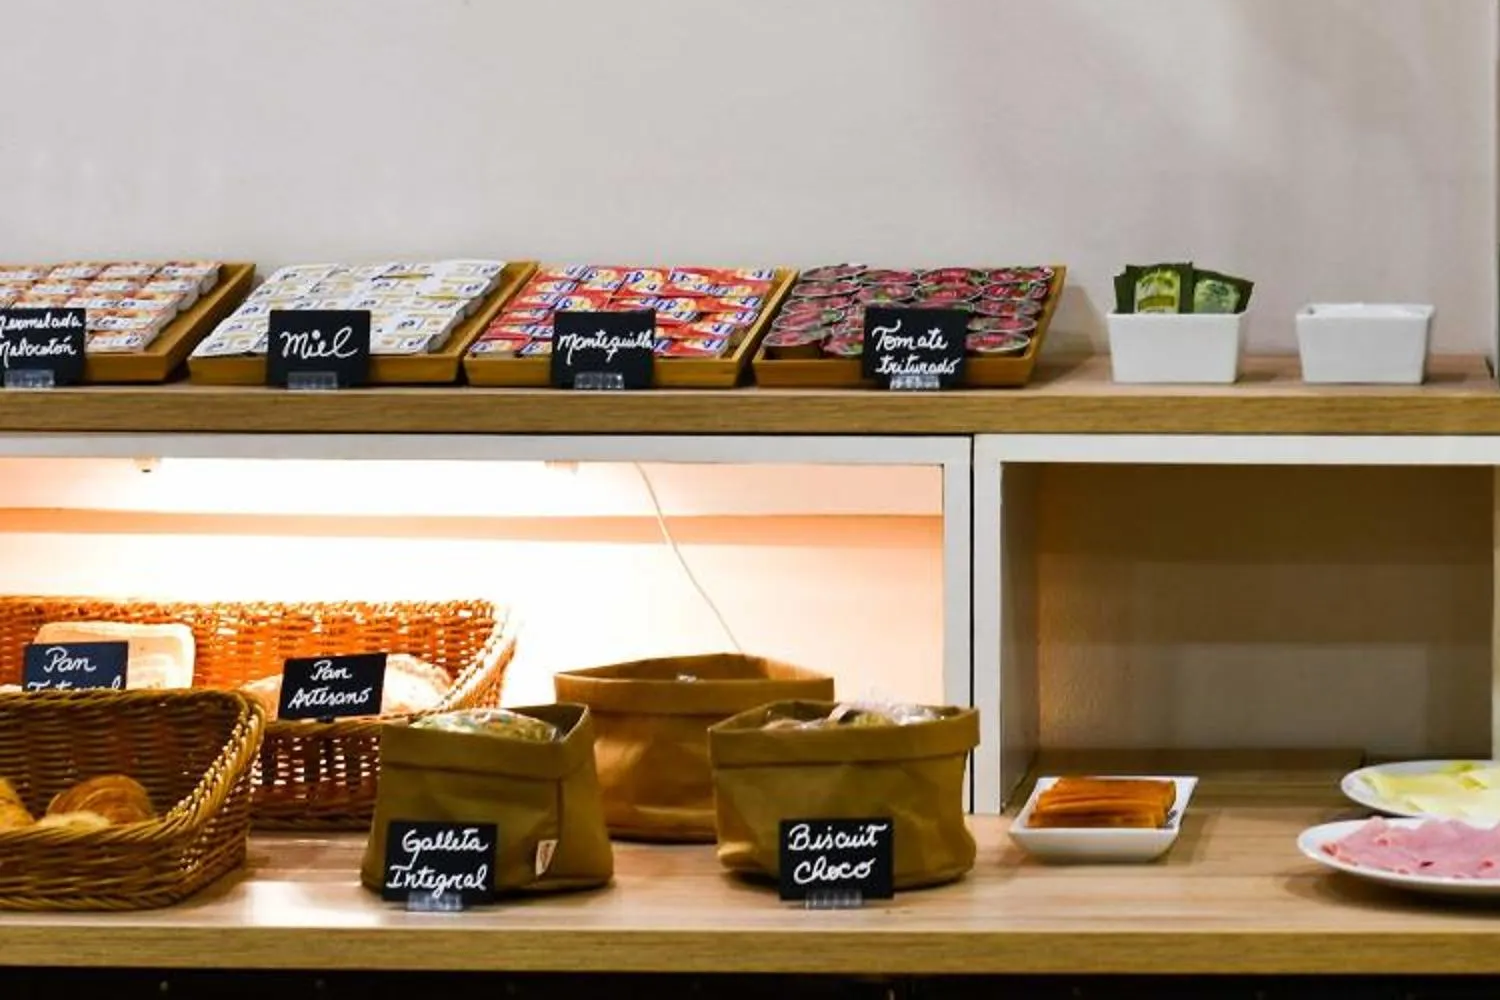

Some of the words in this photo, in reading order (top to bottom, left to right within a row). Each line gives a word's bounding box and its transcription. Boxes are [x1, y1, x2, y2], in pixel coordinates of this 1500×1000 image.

[0, 311, 82, 338] ermelada
[872, 319, 948, 352] Tomate
[280, 325, 358, 359] Miel
[43, 646, 96, 672] Pan
[310, 659, 352, 680] Pan
[402, 828, 489, 867] Galleta
[788, 823, 888, 851] Biscuit
[385, 864, 488, 899] Integral
